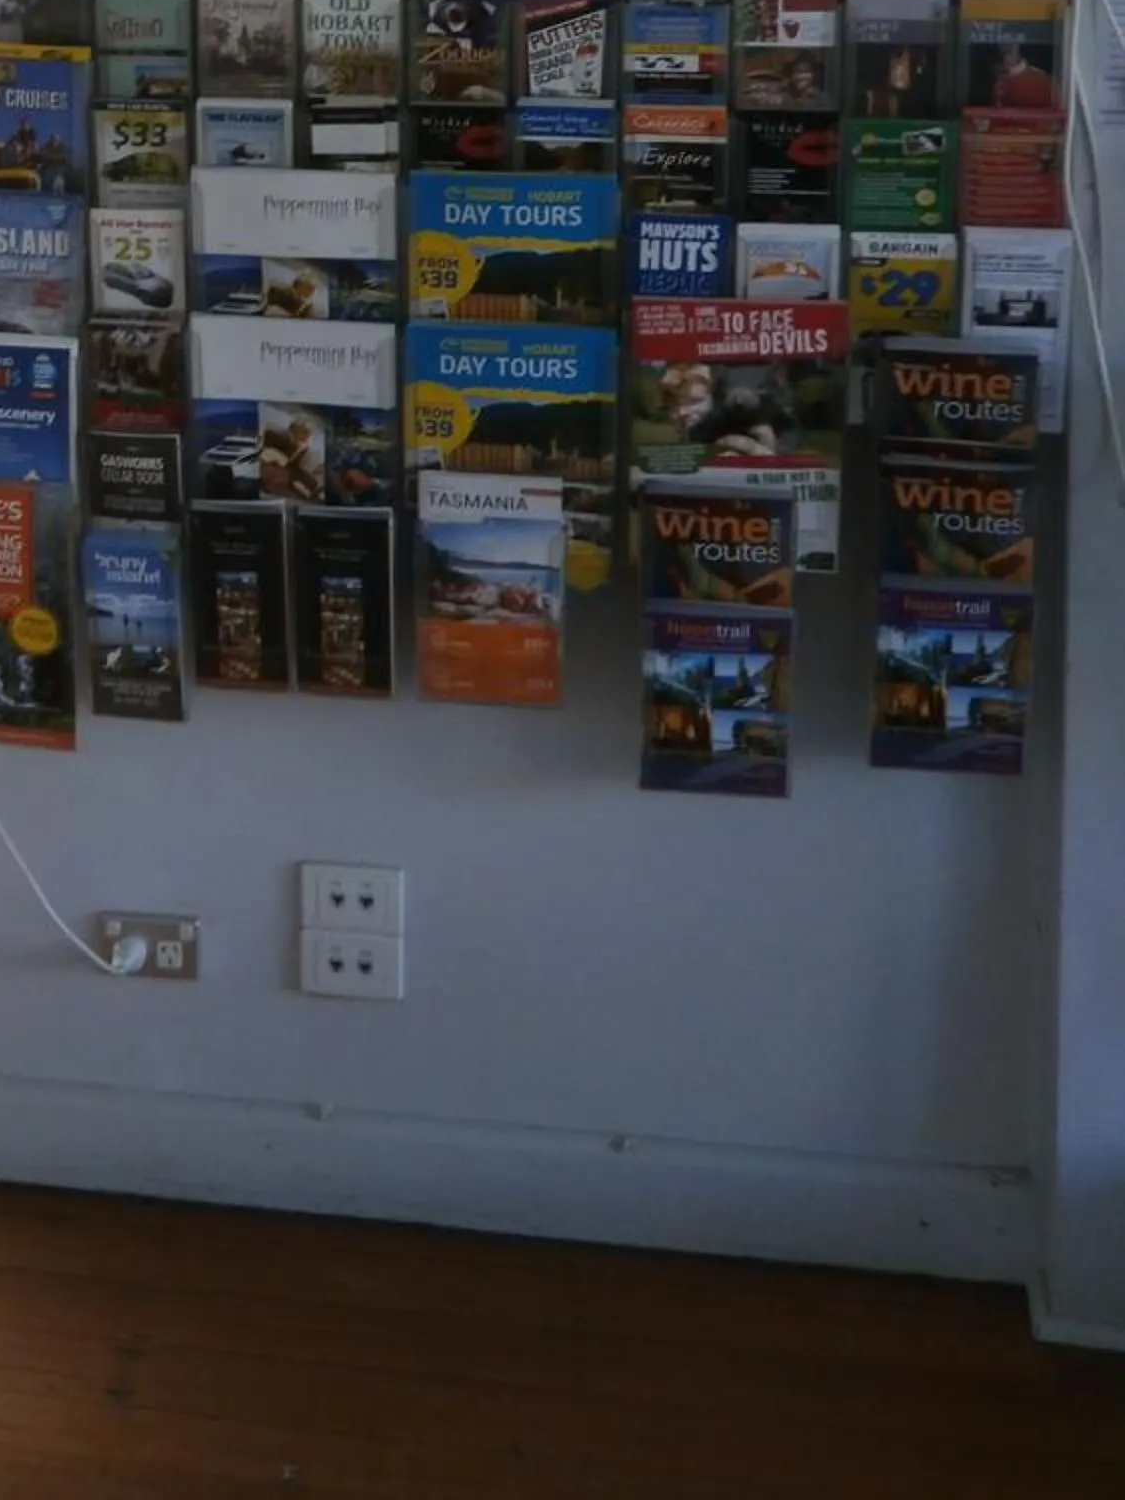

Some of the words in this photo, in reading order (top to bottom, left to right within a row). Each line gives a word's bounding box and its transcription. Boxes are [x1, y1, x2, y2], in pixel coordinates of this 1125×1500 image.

[307, 14, 395, 33] HOBART
[530, 12, 604, 50] PUTTERS
[319, 33, 381, 49] TOWN
[4, 87, 69, 110] CRUISES
[113, 116, 168, 150] $33
[642, 147, 713, 171] Explore
[263, 194, 349, 222] Peppermint
[444, 203, 492, 225] DAY
[500, 204, 583, 227] TOURS
[639, 220, 721, 240] MAWSON'S
[639, 239, 719, 273] HUTS
[868, 241, 939, 255] BARGAIN
[722, 311, 744, 334] TO
[750, 308, 794, 333] FACE
[759, 328, 829, 356] DEVILS
[261, 341, 346, 369] Peppermint
[439, 354, 488, 376] DAY
[494, 357, 579, 379] TOURS
[893, 362, 1013, 402] wine
[933, 399, 1025, 422] routes
[427, 491, 529, 512] TASMANIA
[893, 475, 1013, 515] wine
[655, 507, 769, 544] wine
[933, 511, 1025, 535] routes
[693, 540, 781, 564] routes
